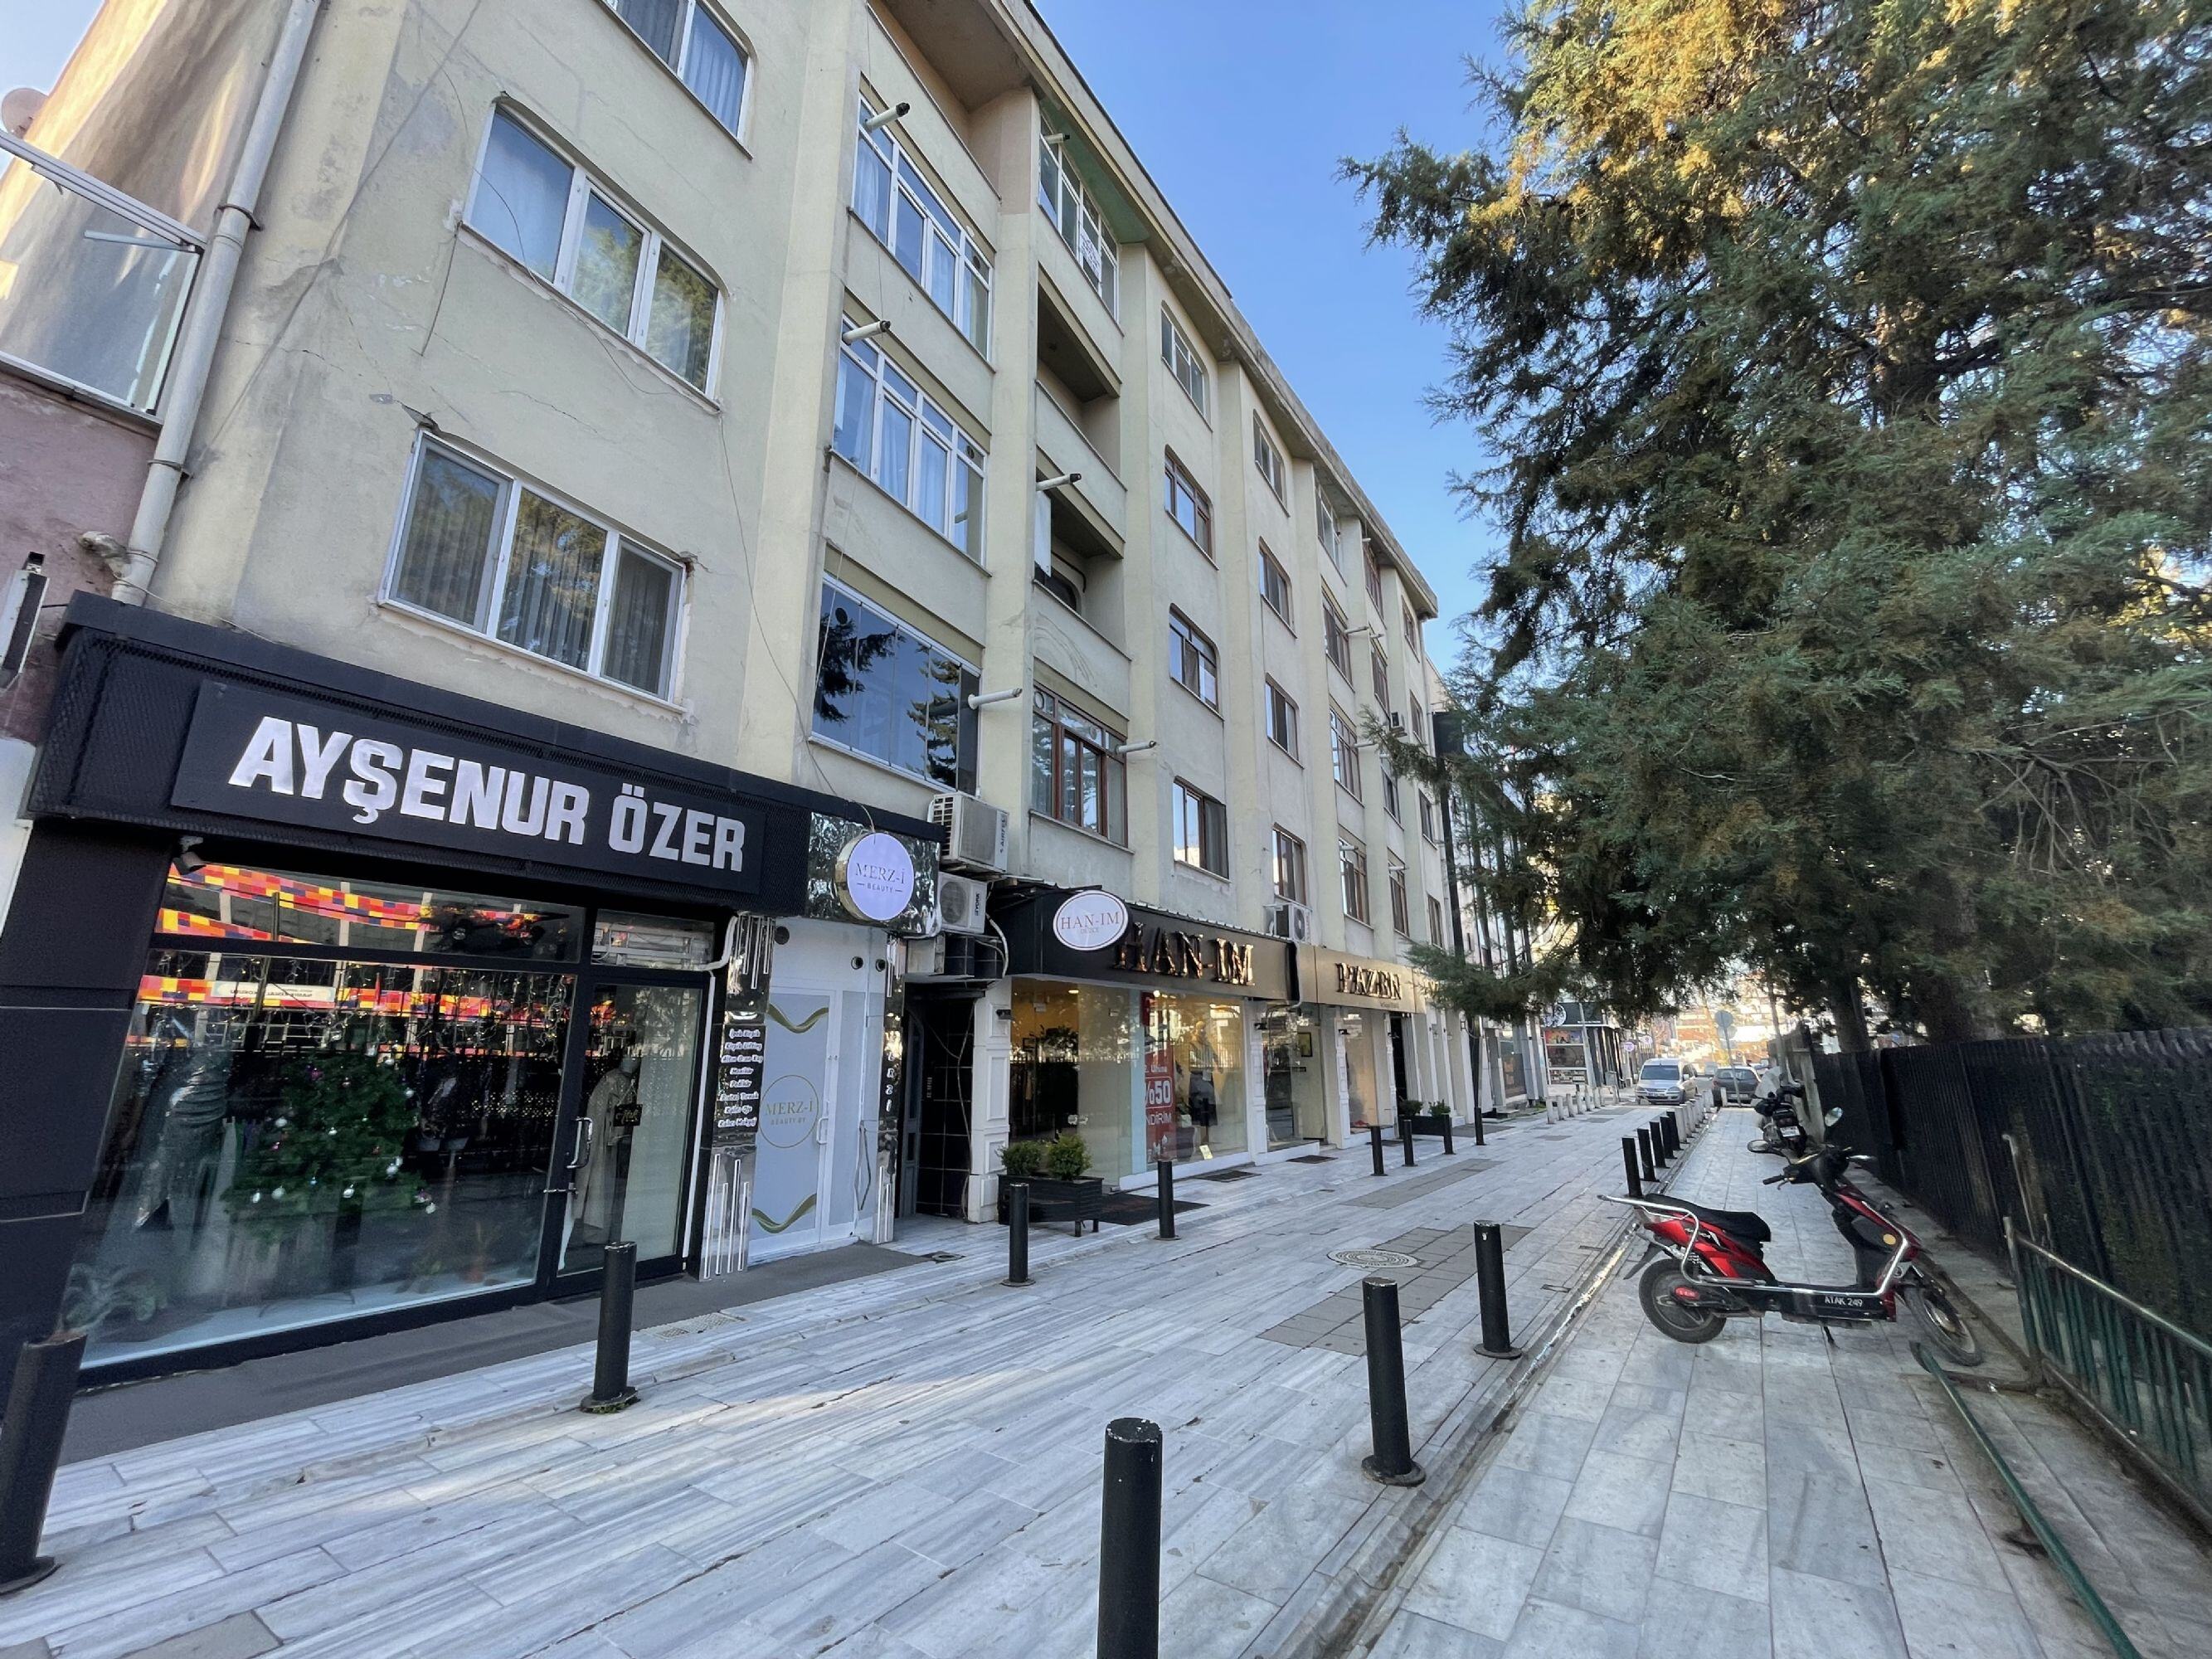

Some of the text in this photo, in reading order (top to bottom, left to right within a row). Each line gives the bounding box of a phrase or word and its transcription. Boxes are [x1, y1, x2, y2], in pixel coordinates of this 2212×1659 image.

[228, 716, 746, 873] AYŞENUR ÖZER
[867, 883, 893, 893] BEAUTY
[1061, 912, 1120, 930] HAN-IM
[1112, 921, 1255, 986] HAN-IM
[1145, 1112, 1172, 1126] NDİRİM
